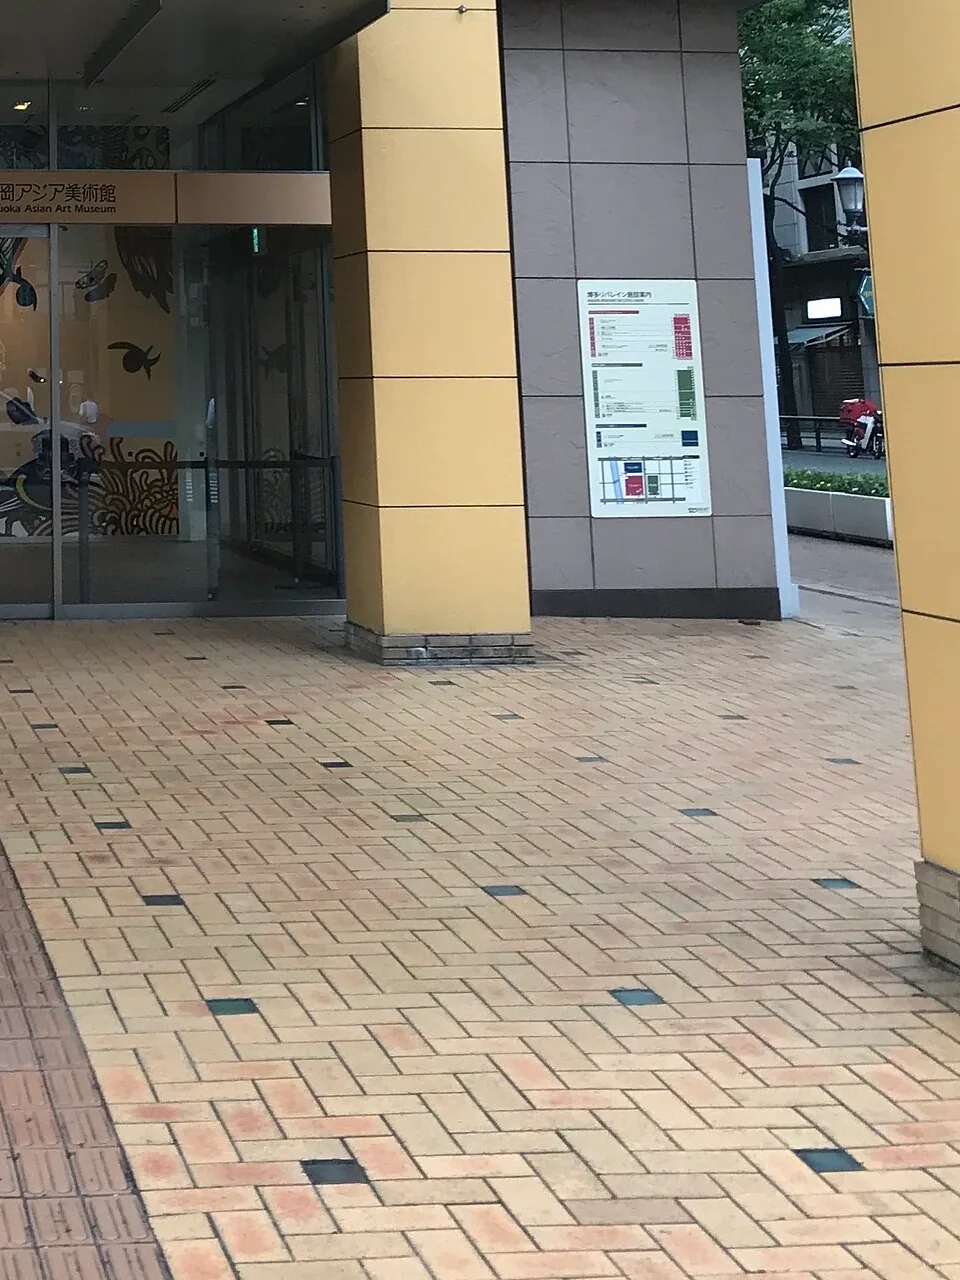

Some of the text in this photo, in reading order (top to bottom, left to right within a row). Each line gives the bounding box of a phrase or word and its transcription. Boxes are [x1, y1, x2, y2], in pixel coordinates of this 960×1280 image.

[24, 204, 52, 213] Asian
[55, 204, 72, 213] Art
[74, 204, 117, 213] Museum
